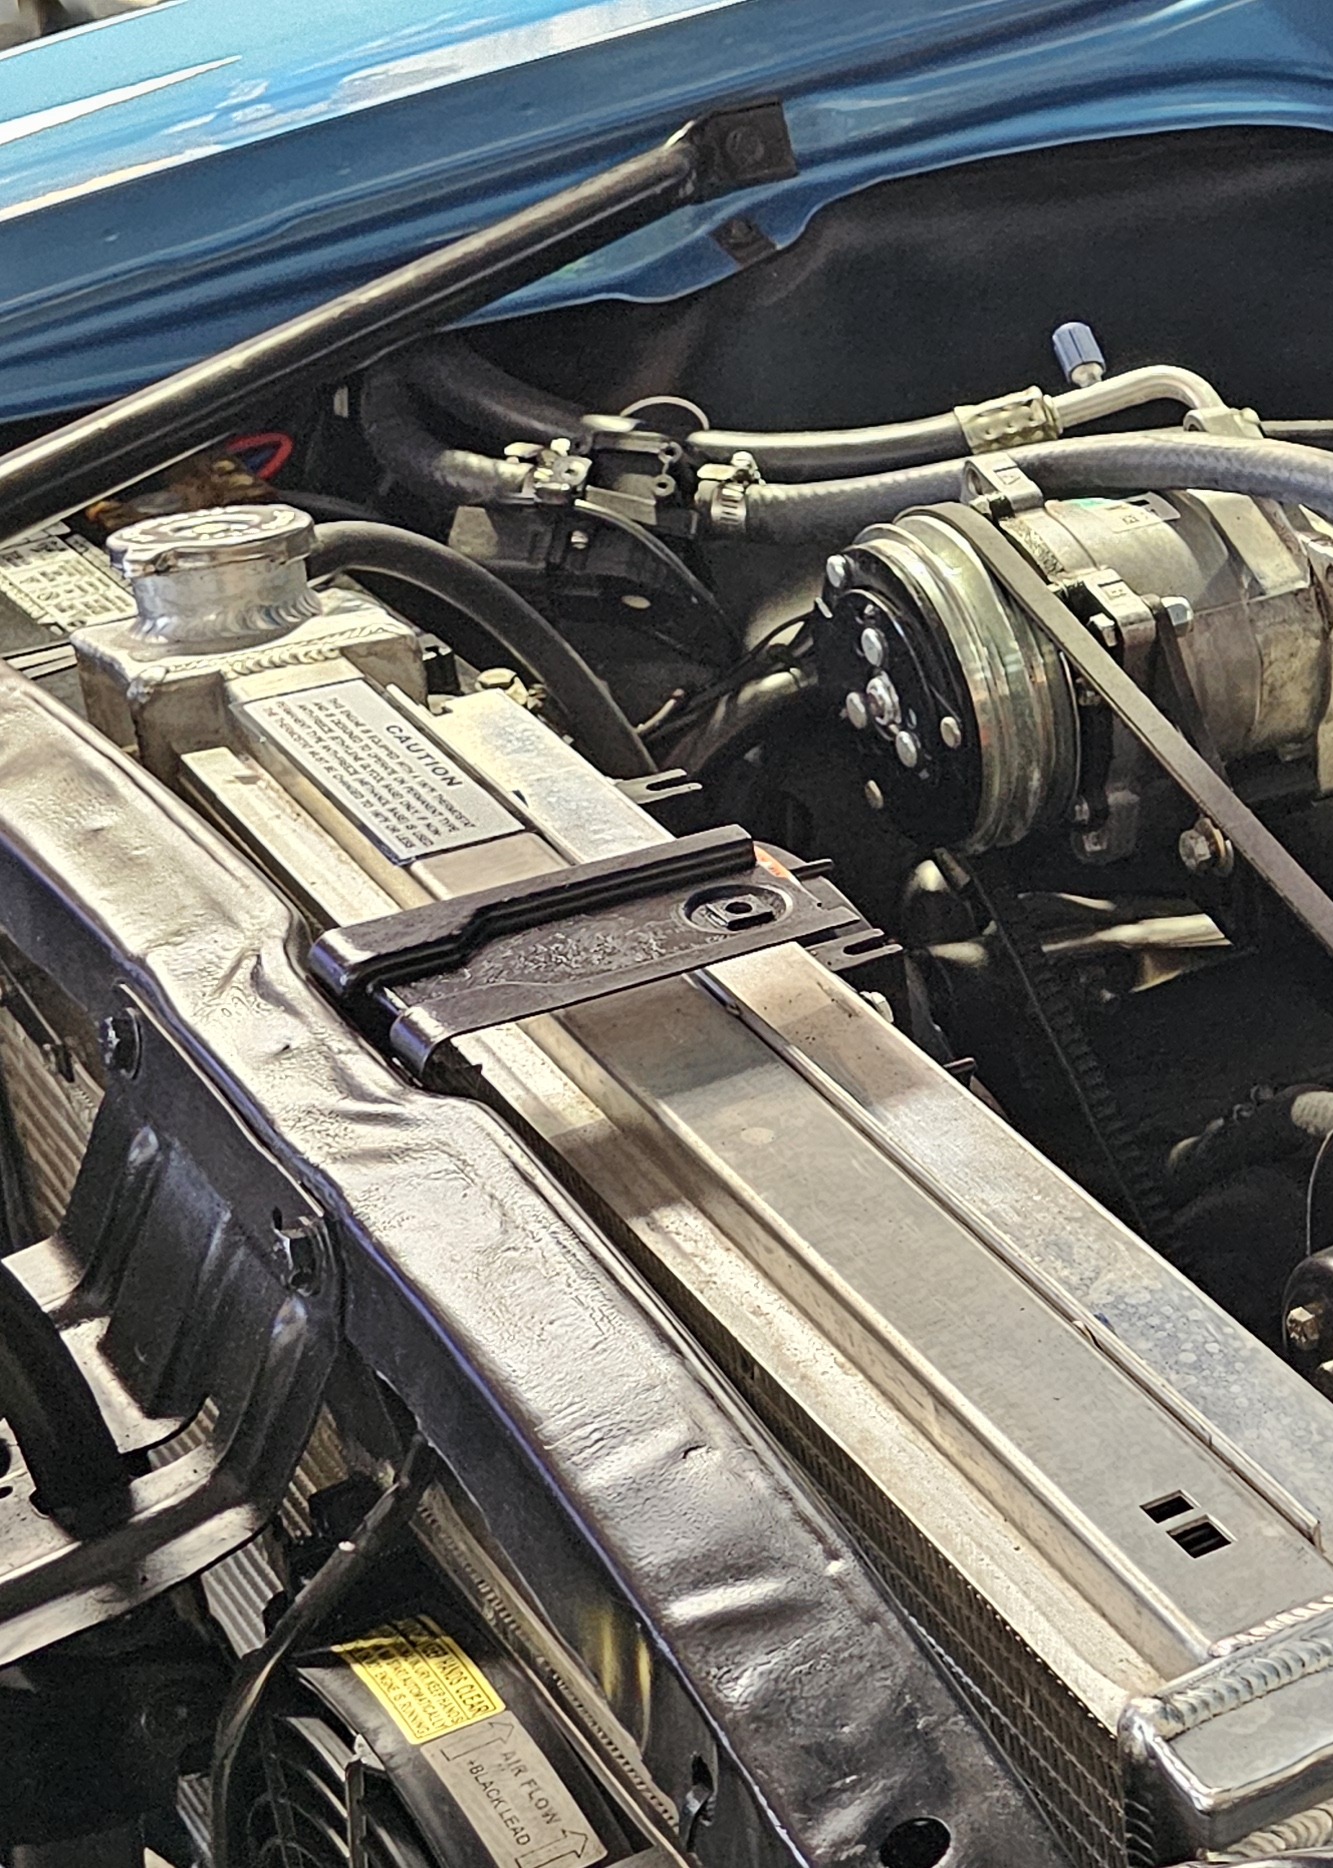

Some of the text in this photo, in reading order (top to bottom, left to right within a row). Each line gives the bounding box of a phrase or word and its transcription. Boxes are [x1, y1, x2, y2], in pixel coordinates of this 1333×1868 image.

[382, 724, 463, 787] CAUTION
[400, 1675, 449, 1729] AUTOMATICALLY
[424, 1679, 446, 1698] KEEP
[436, 1696, 465, 1724] HANDS
[436, 1654, 468, 1686] HANDS
[456, 1682, 491, 1716] CLEAR
[398, 1700, 430, 1735] RUNNING
[501, 1751, 562, 1826] AIR FLOW
[499, 1808, 531, 1847] LEAD
